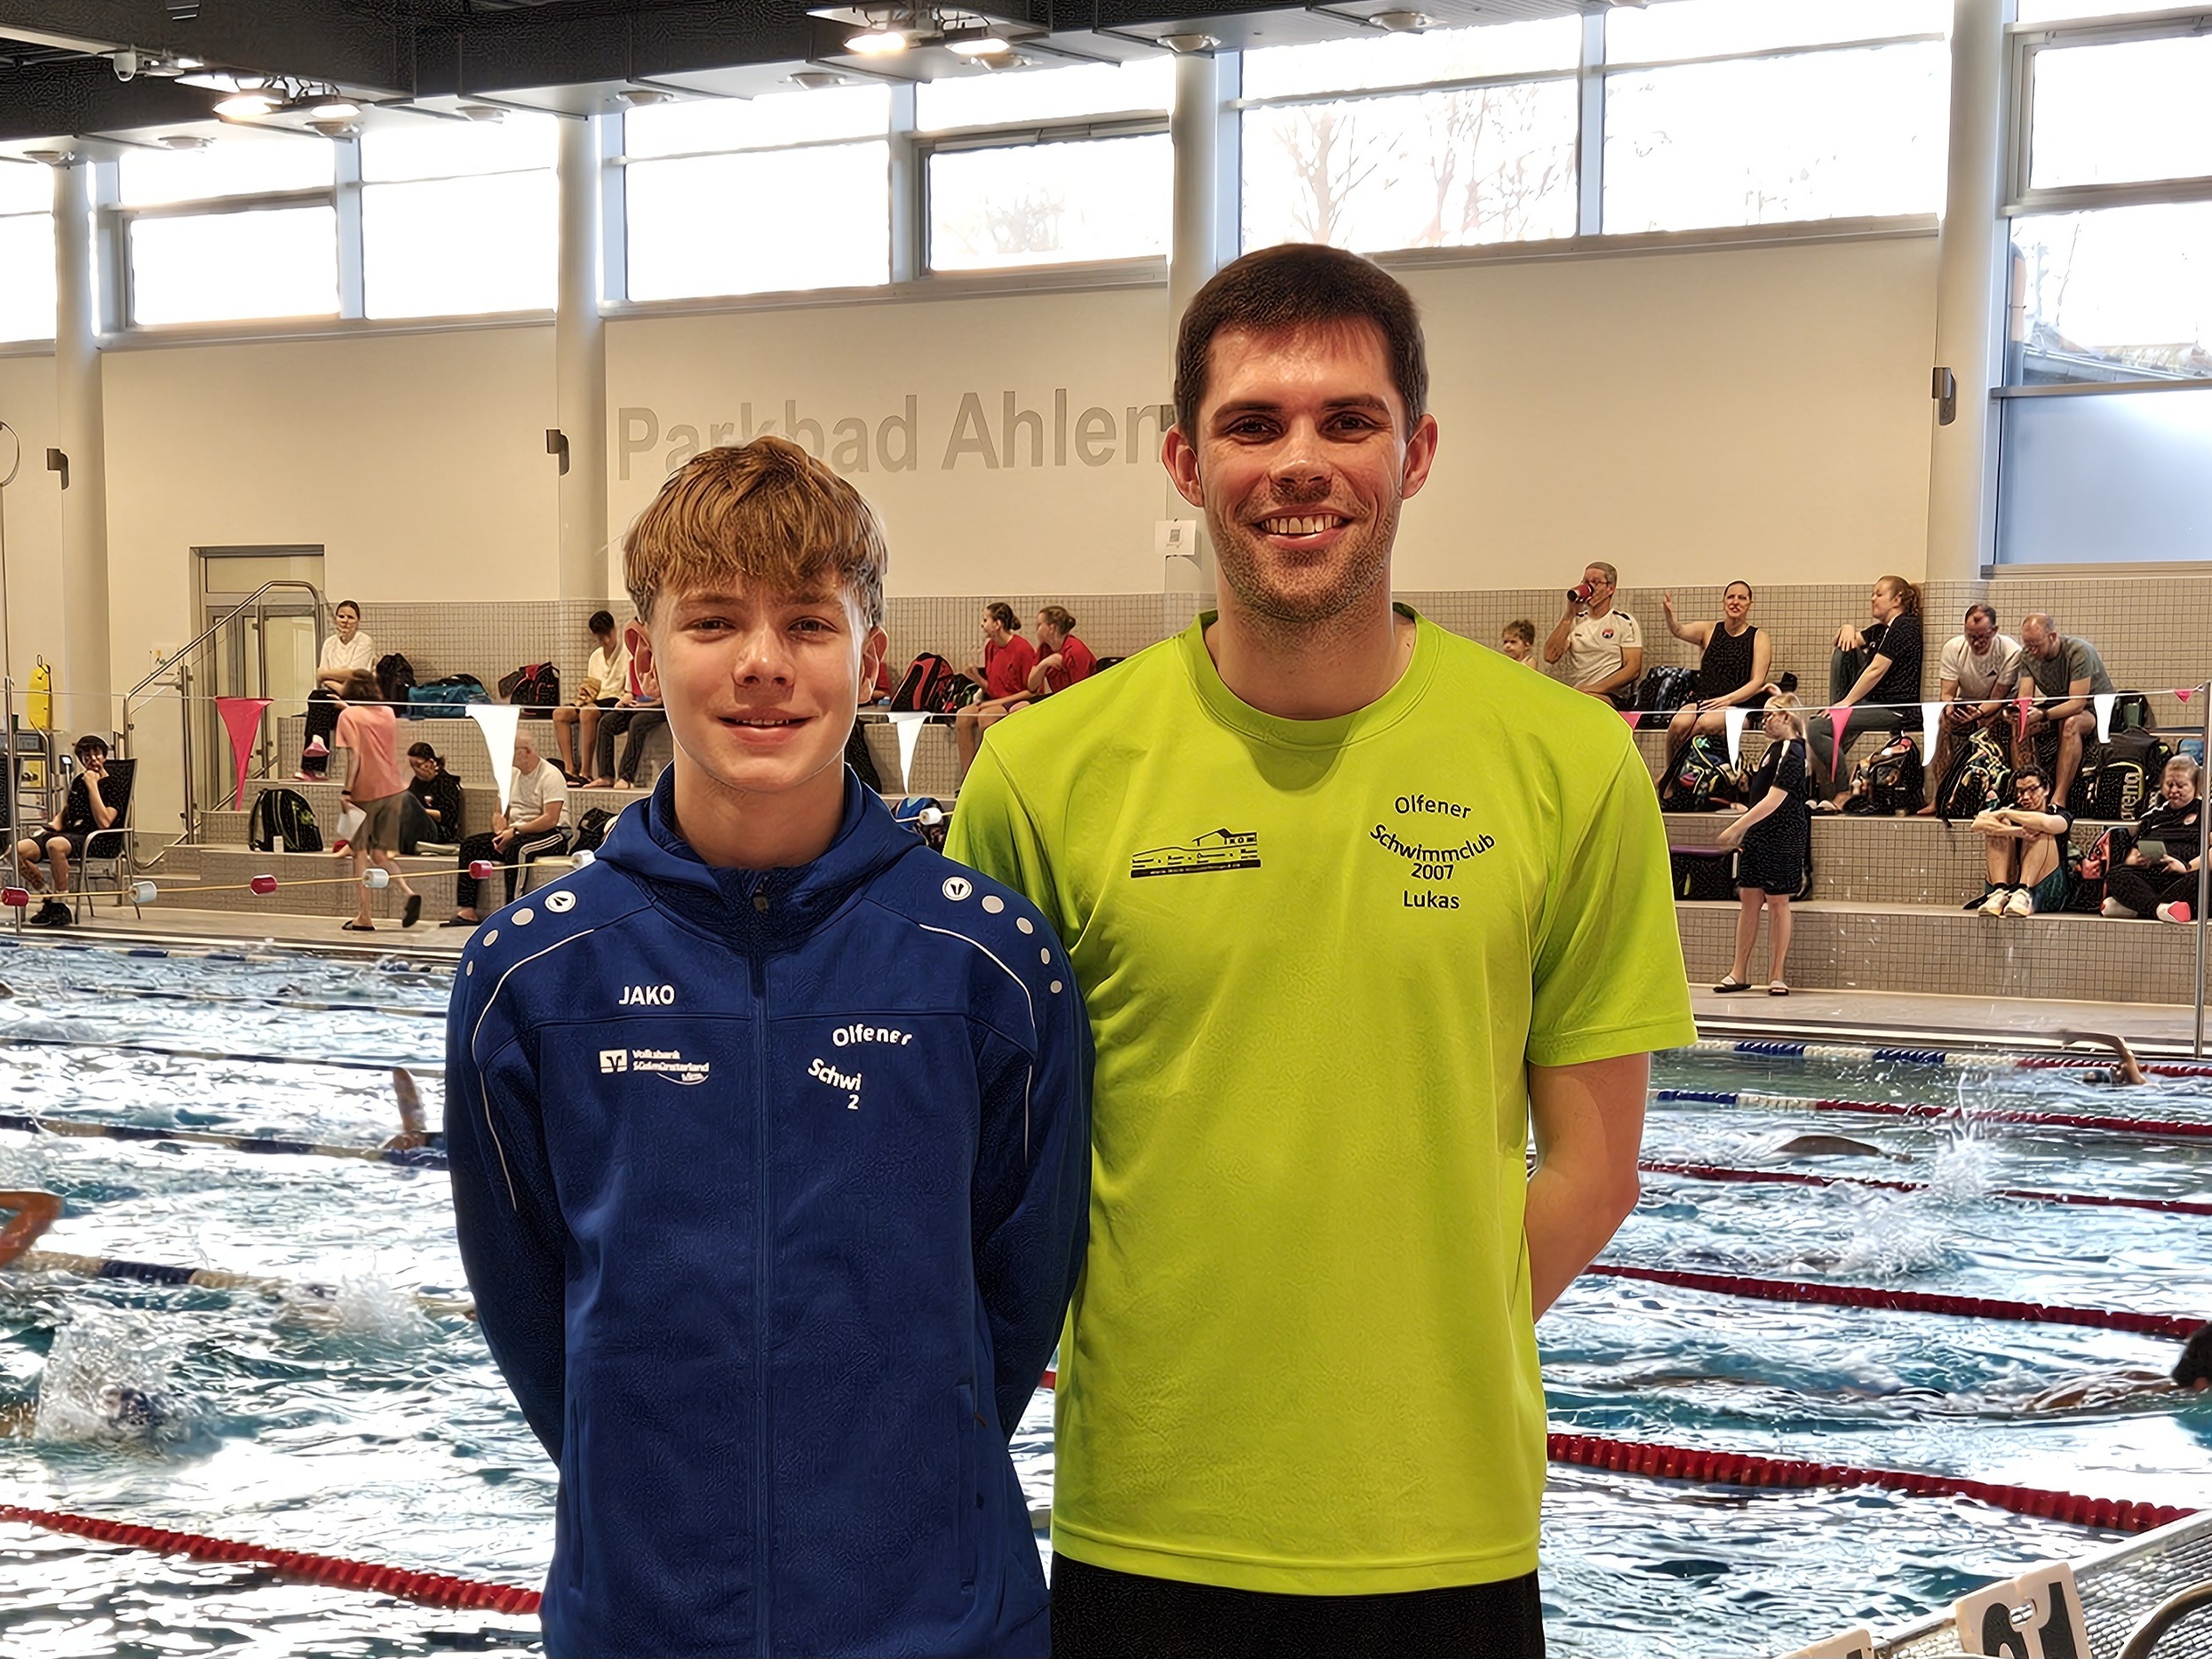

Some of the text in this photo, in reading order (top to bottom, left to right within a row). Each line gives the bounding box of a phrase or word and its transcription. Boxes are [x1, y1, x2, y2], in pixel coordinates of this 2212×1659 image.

[941, 388, 1161, 470] Ahlen
[1395, 794, 1472, 819] Olfener
[1370, 824, 1495, 862] Schwimmclub
[1411, 863, 1454, 880] 2007
[1404, 889, 1460, 909] Lukas
[618, 985, 675, 1005] JAKO
[832, 1023, 913, 1047] Olfener
[808, 1057, 863, 1091] Schwi
[847, 1094, 859, 1110] 2
